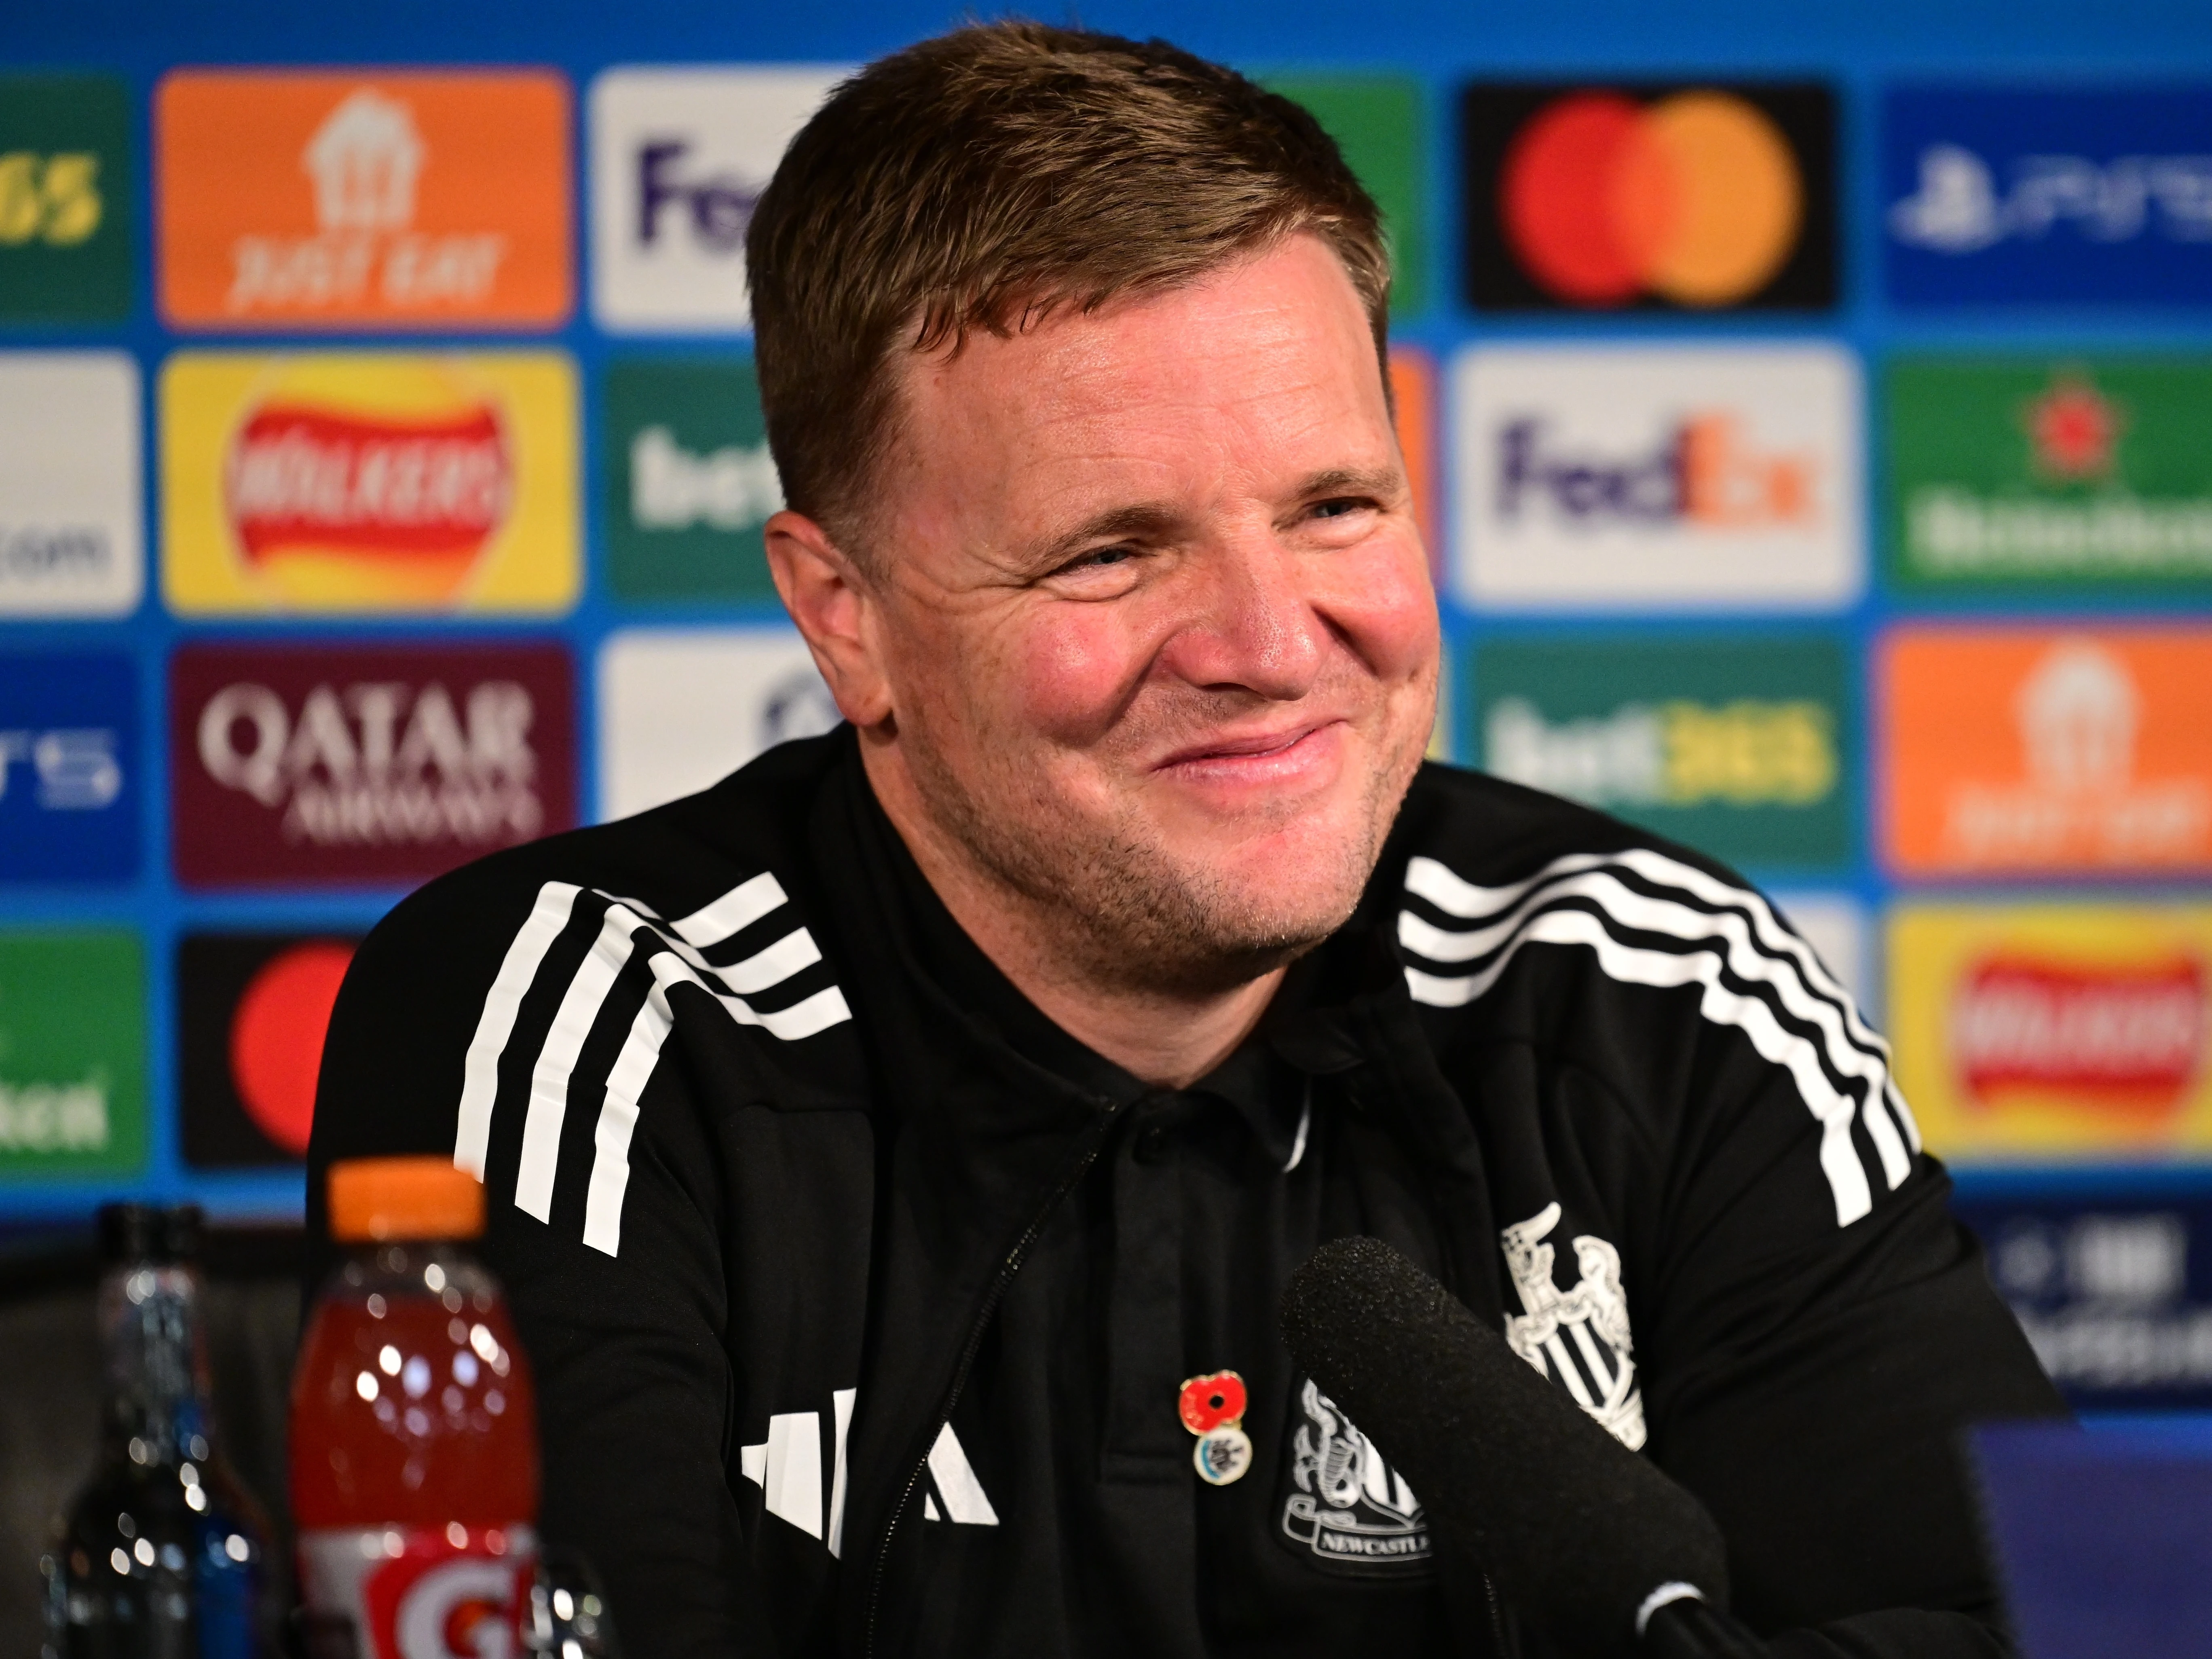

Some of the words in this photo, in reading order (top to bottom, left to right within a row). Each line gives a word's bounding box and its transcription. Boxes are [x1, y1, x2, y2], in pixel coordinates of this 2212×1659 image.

[226, 235, 375, 313] JUST
[382, 234, 507, 303] EAT
[1494, 412, 1815, 530] FedEx
[199, 681, 538, 805] QATAR
[395, 1557, 517, 1659] G
